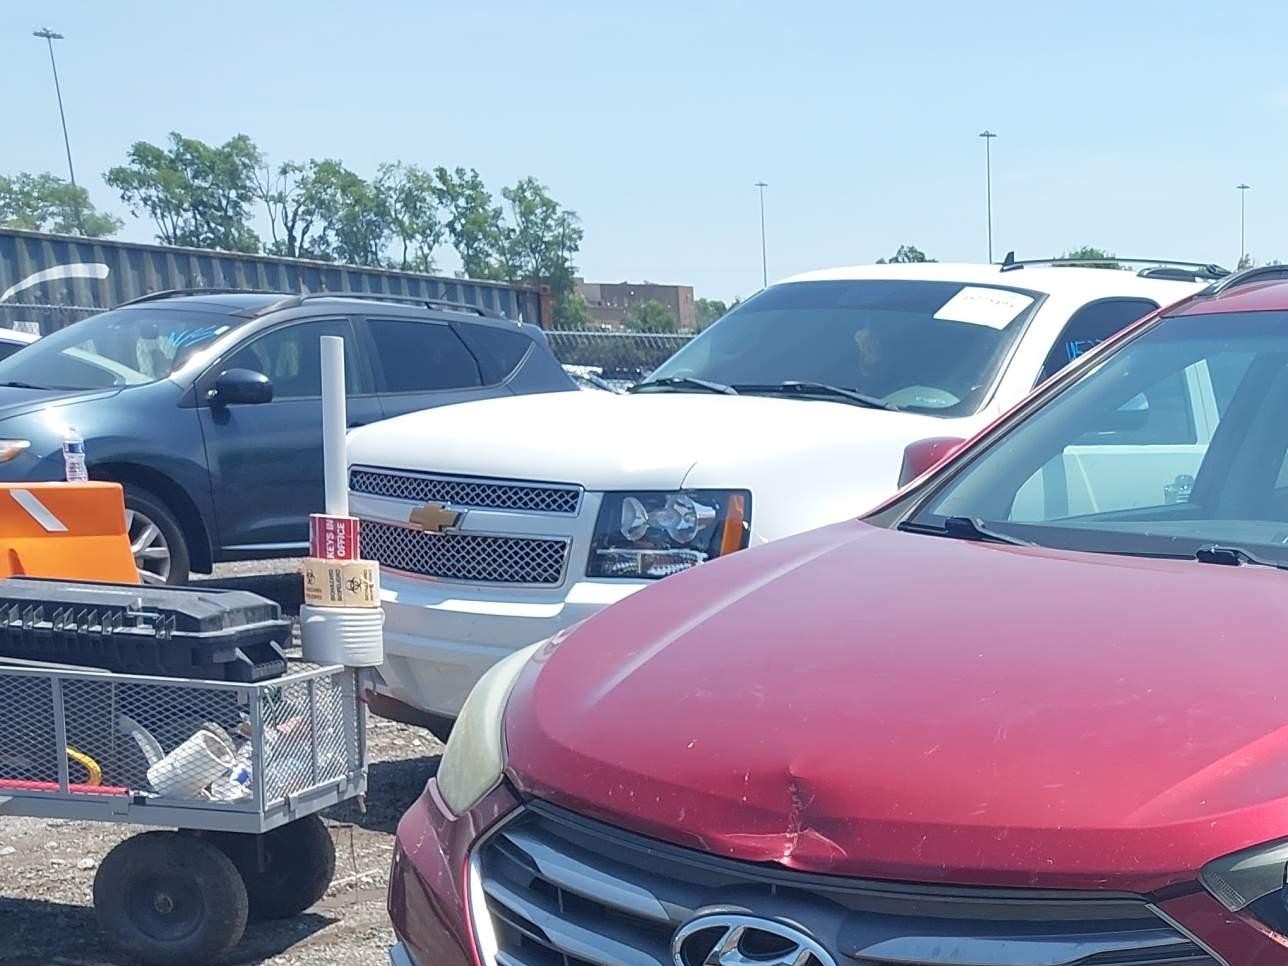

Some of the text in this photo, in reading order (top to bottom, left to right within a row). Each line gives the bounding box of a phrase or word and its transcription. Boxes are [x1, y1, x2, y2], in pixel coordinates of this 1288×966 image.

[325, 519, 335, 559] KEYS IN
[336, 522, 346, 558] OFFICE
